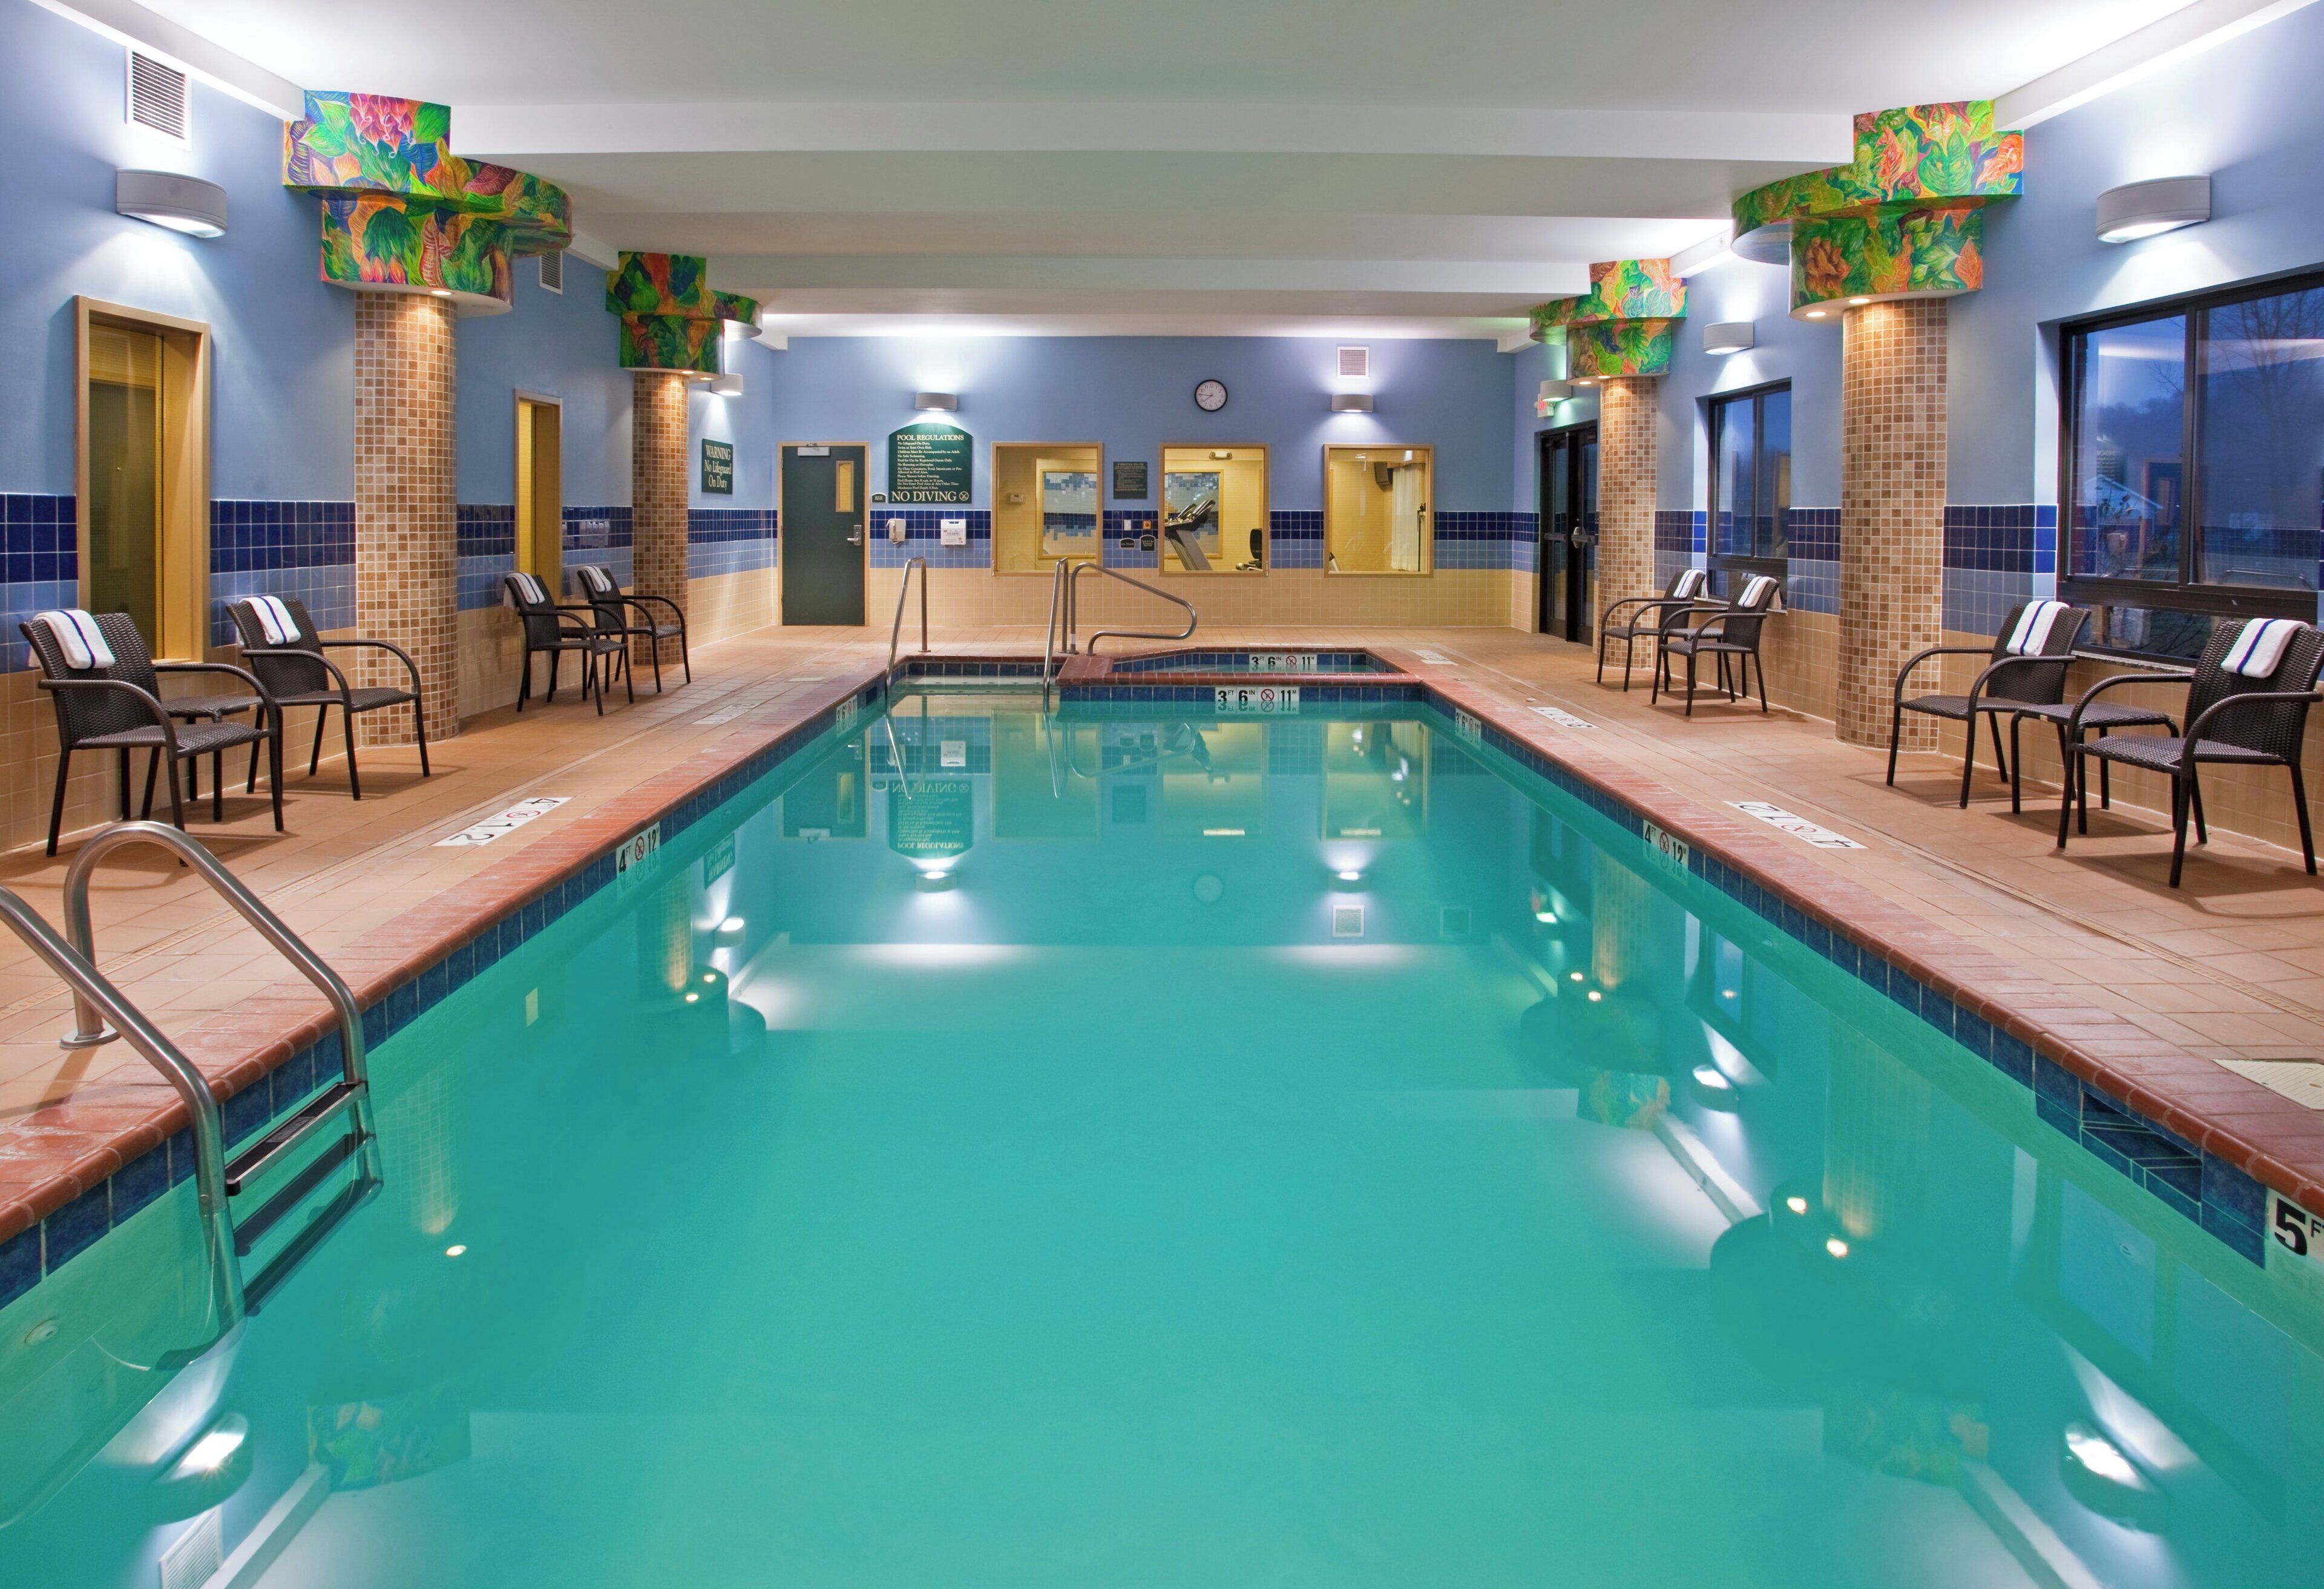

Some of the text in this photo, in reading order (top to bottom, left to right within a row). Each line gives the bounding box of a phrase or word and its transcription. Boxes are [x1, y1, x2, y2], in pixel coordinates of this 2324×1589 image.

[705, 445, 731, 460] WARNING
[704, 459, 731, 476] No Lifeguard
[709, 475, 728, 491] On Duty
[891, 491, 910, 501] NO
[913, 491, 956, 502] DIVING
[1252, 656, 1259, 665] 3
[1268, 656, 1275, 665] 6
[1218, 690, 1227, 701] 3
[1238, 690, 1248, 701] 6
[1645, 824, 1651, 843] 4
[619, 849, 627, 873] 4
[2274, 1198, 2307, 1256] 5
